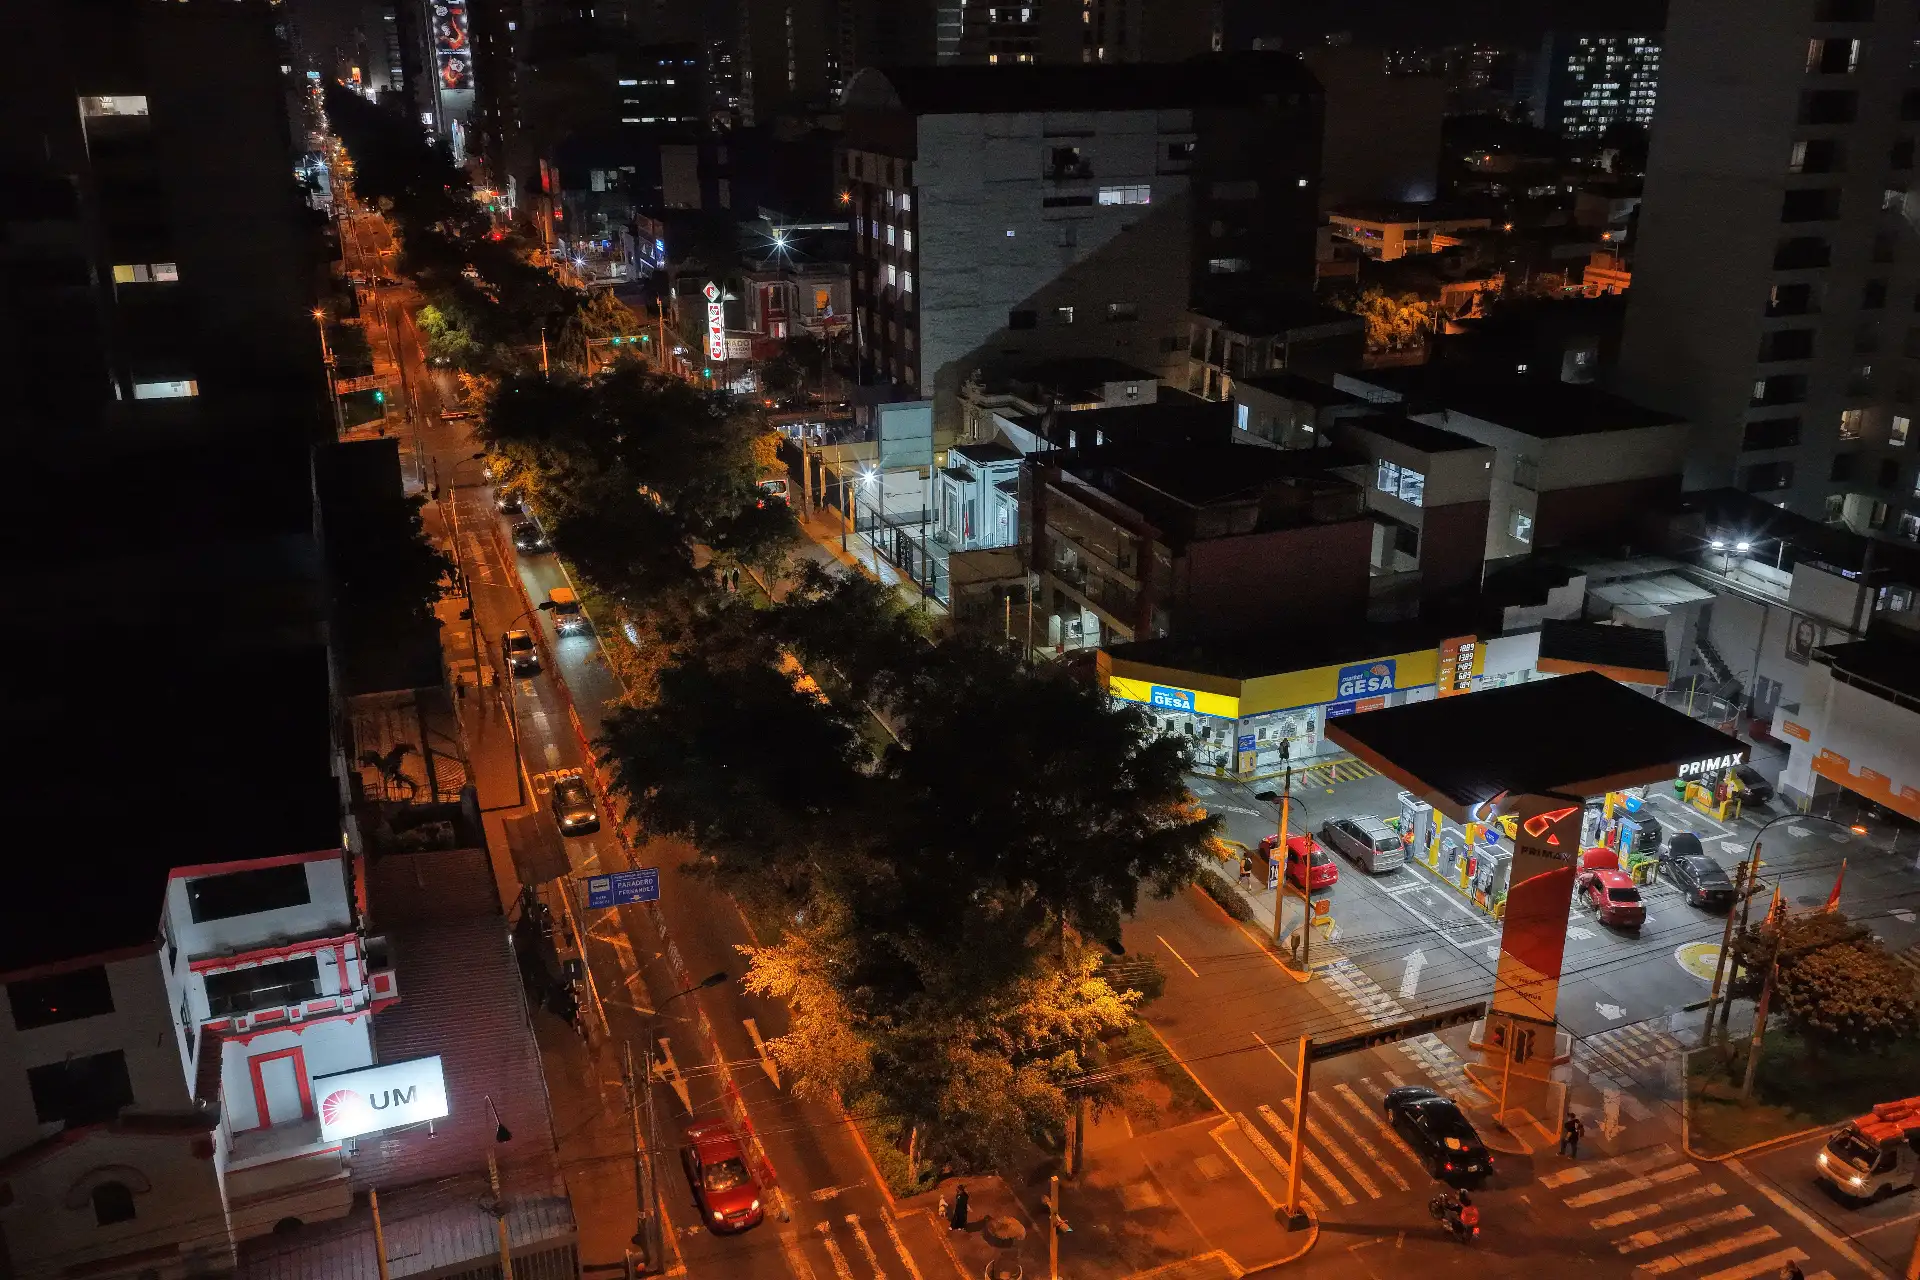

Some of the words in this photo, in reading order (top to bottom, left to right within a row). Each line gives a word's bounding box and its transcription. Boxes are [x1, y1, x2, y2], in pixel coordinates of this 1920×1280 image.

[1342, 673, 1363, 682] market
[1340, 675, 1392, 696] GESA
[1154, 695, 1191, 710] GESA
[1678, 752, 1744, 778] PRIMAX
[1521, 846, 1571, 862] PRIMAX
[617, 878, 654, 889] PARADERO
